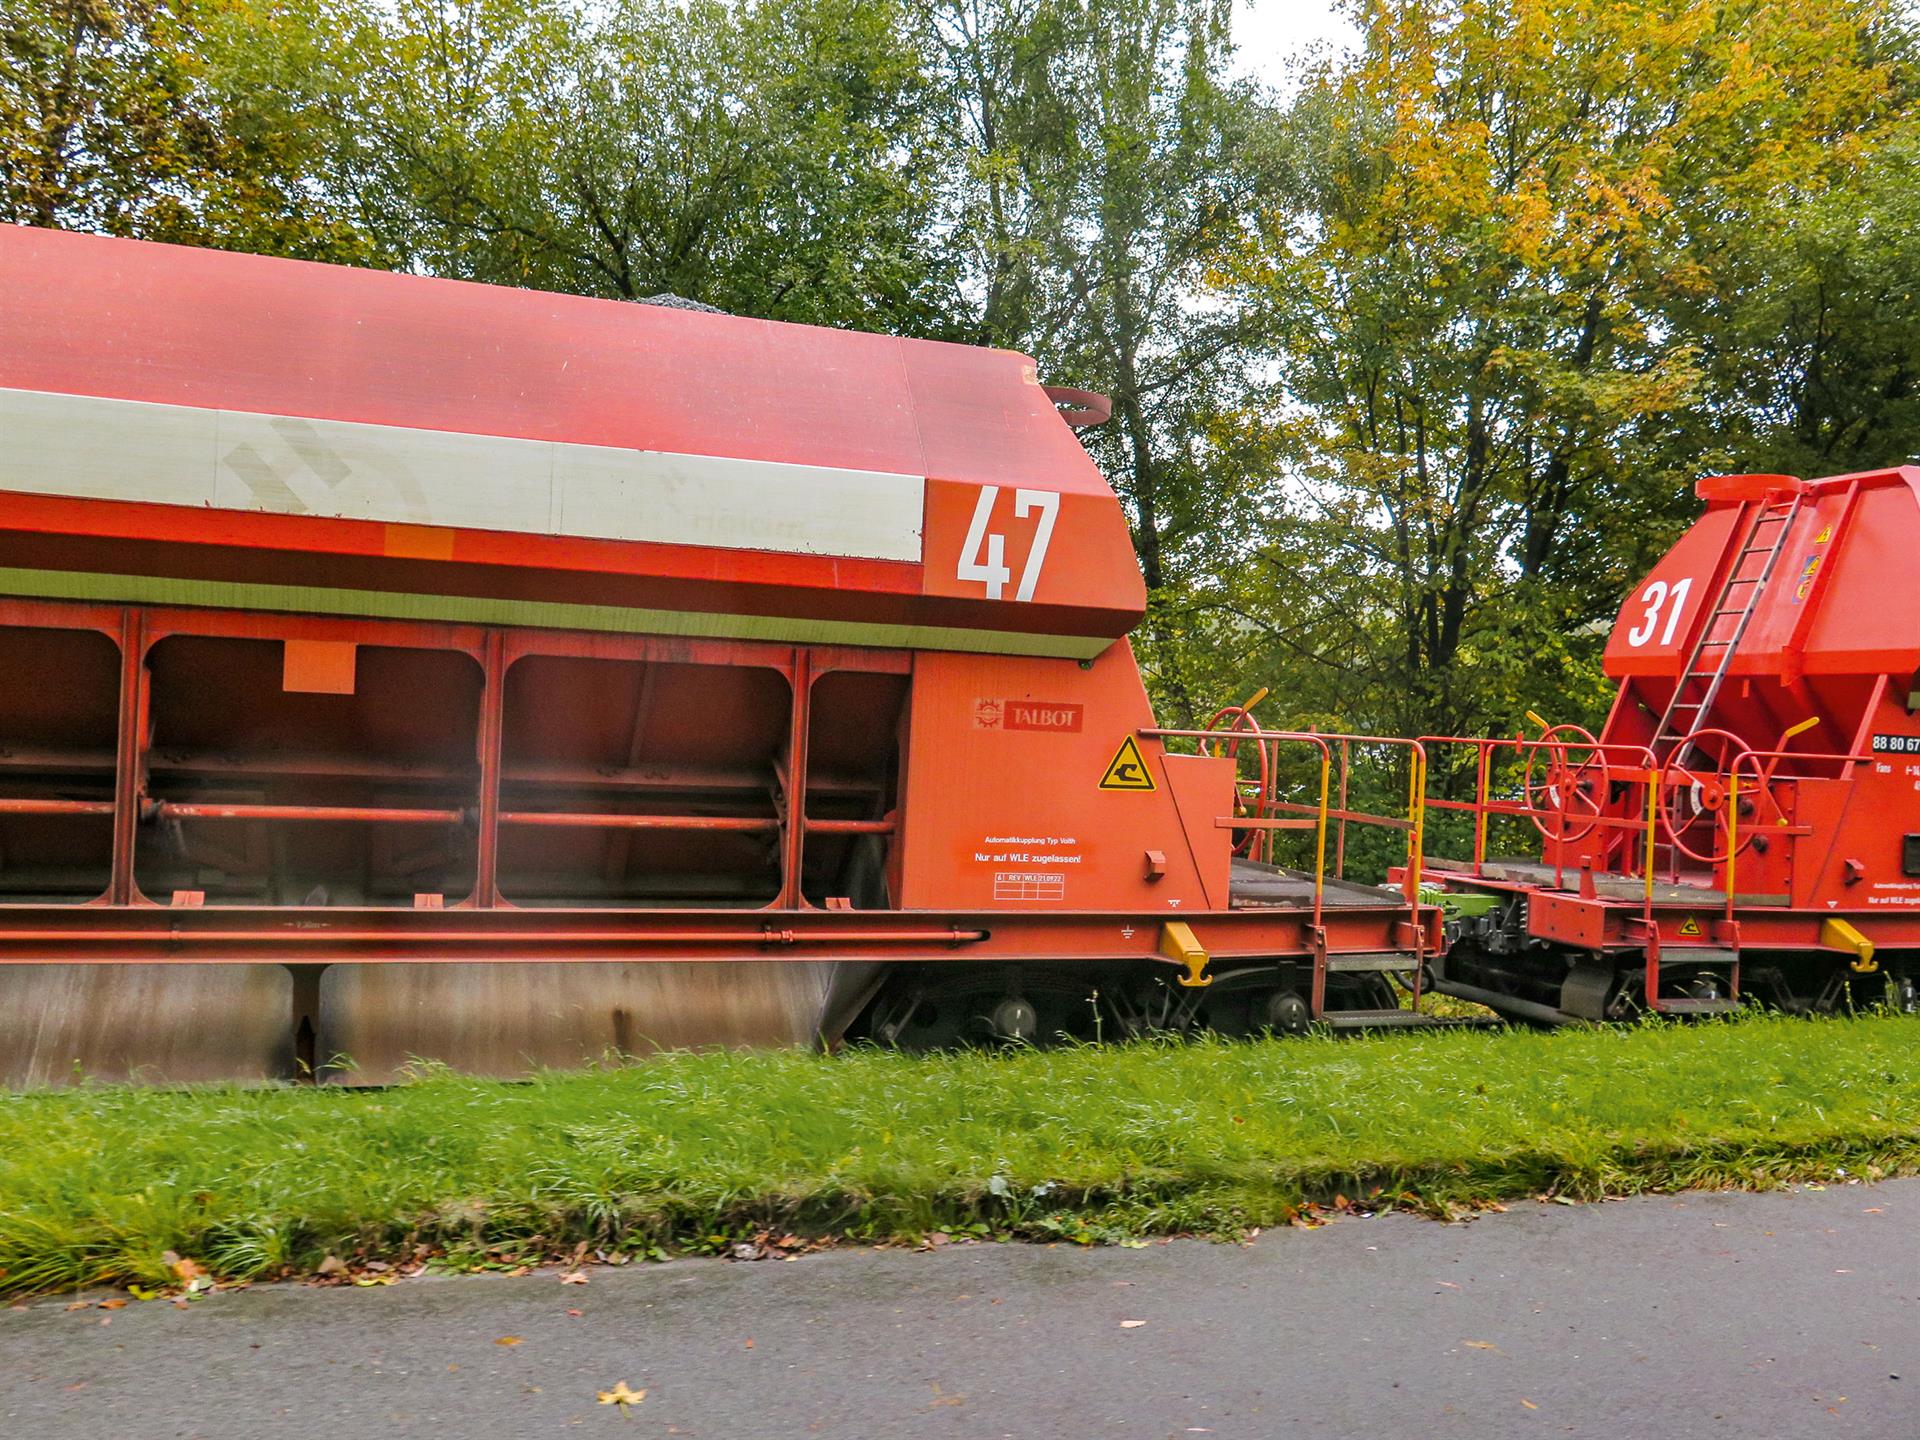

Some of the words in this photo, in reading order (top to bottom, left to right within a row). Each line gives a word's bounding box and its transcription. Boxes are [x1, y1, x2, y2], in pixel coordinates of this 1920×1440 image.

[957, 485, 1060, 602] 47
[1628, 578, 1693, 647] 31
[1012, 707, 1077, 727] TALBOT
[1873, 735, 1887, 749] 88
[1890, 737, 1904, 750] 80
[1047, 837, 1058, 845] Typ
[975, 853, 990, 861] Nur
[993, 853, 1007, 862] auf
[1009, 853, 1030, 862] WLE
[1032, 855, 1082, 863] zugelassen!
